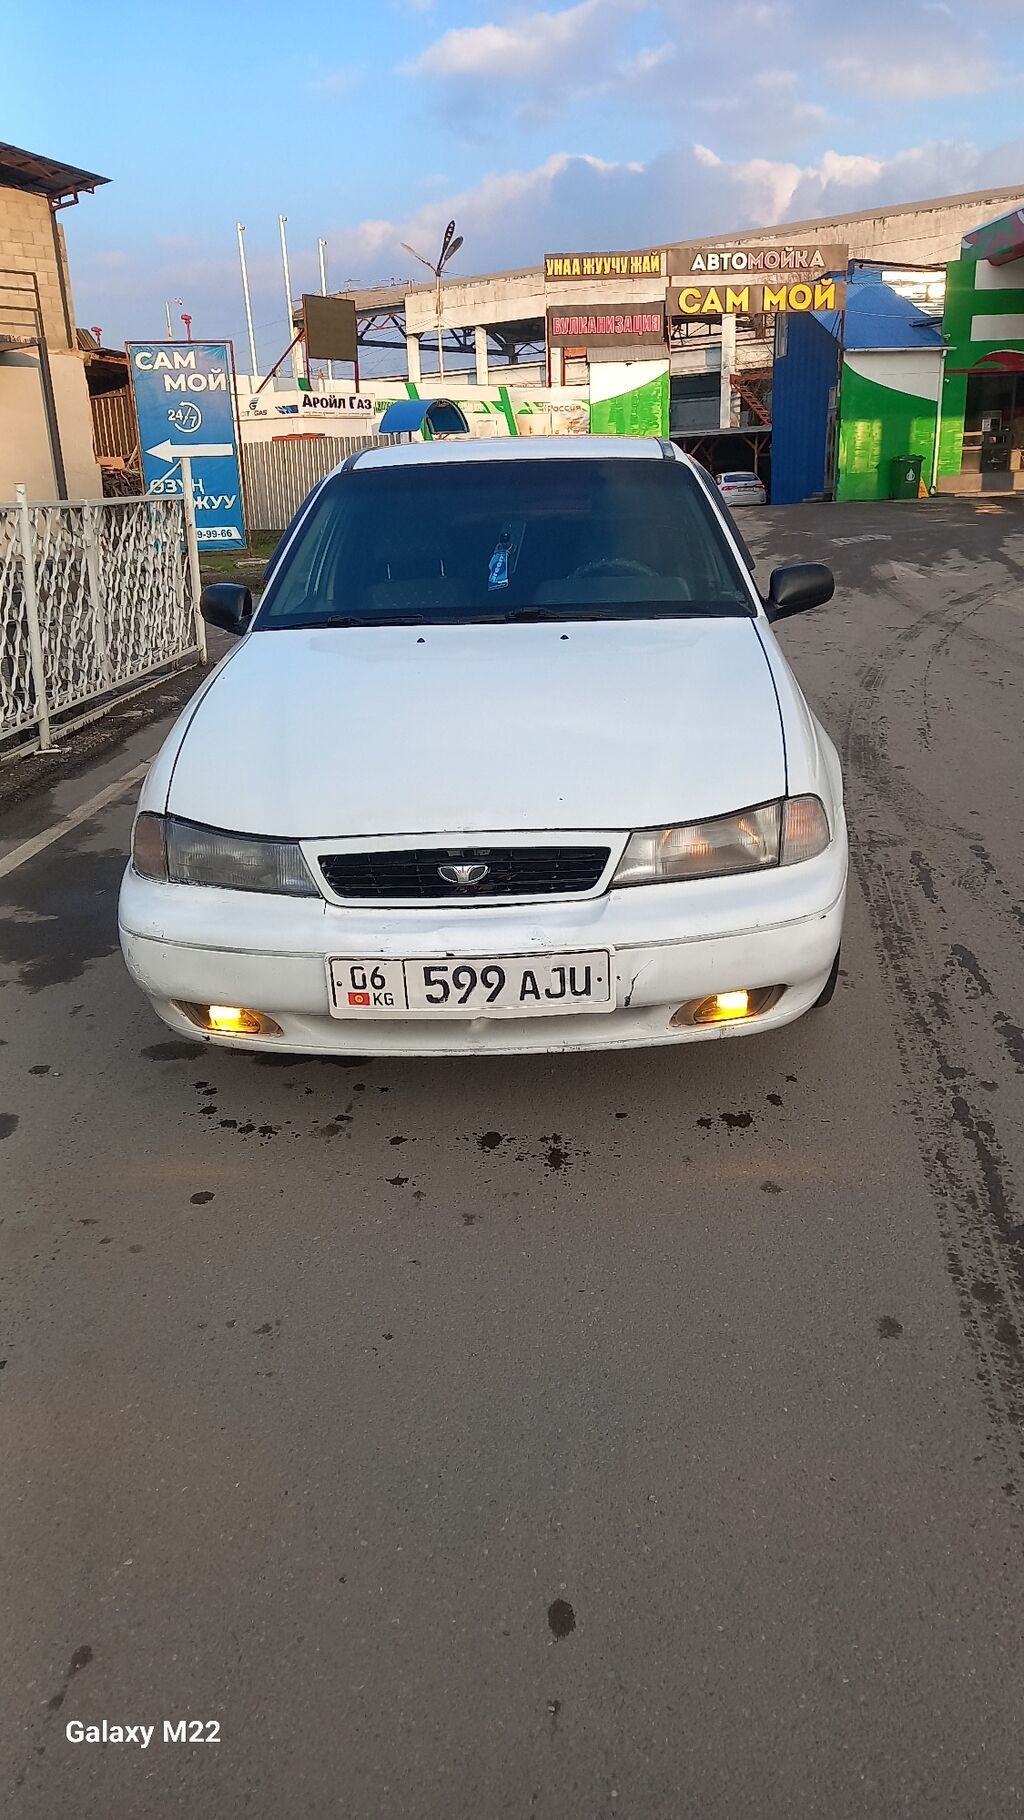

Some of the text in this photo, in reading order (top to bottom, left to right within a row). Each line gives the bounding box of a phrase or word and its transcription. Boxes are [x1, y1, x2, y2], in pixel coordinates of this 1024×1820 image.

[546, 251, 660, 276] УНАА ЖУУЧУ ЖАЙ
[690, 246, 825, 272] АВТОМОЙКА
[677, 279, 837, 314] САМ МОЙ
[552, 314, 661, 336] ВУЛКАНИЗАЦИЯ
[134, 350, 196, 370] САМ
[163, 368, 227, 392] МОЙ
[168, 407, 198, 428] 24/7
[197, 529, 233, 539] 9-99-66
[350, 964, 592, 1004] 06 599 AJU
[373, 991, 395, 1007] KG
